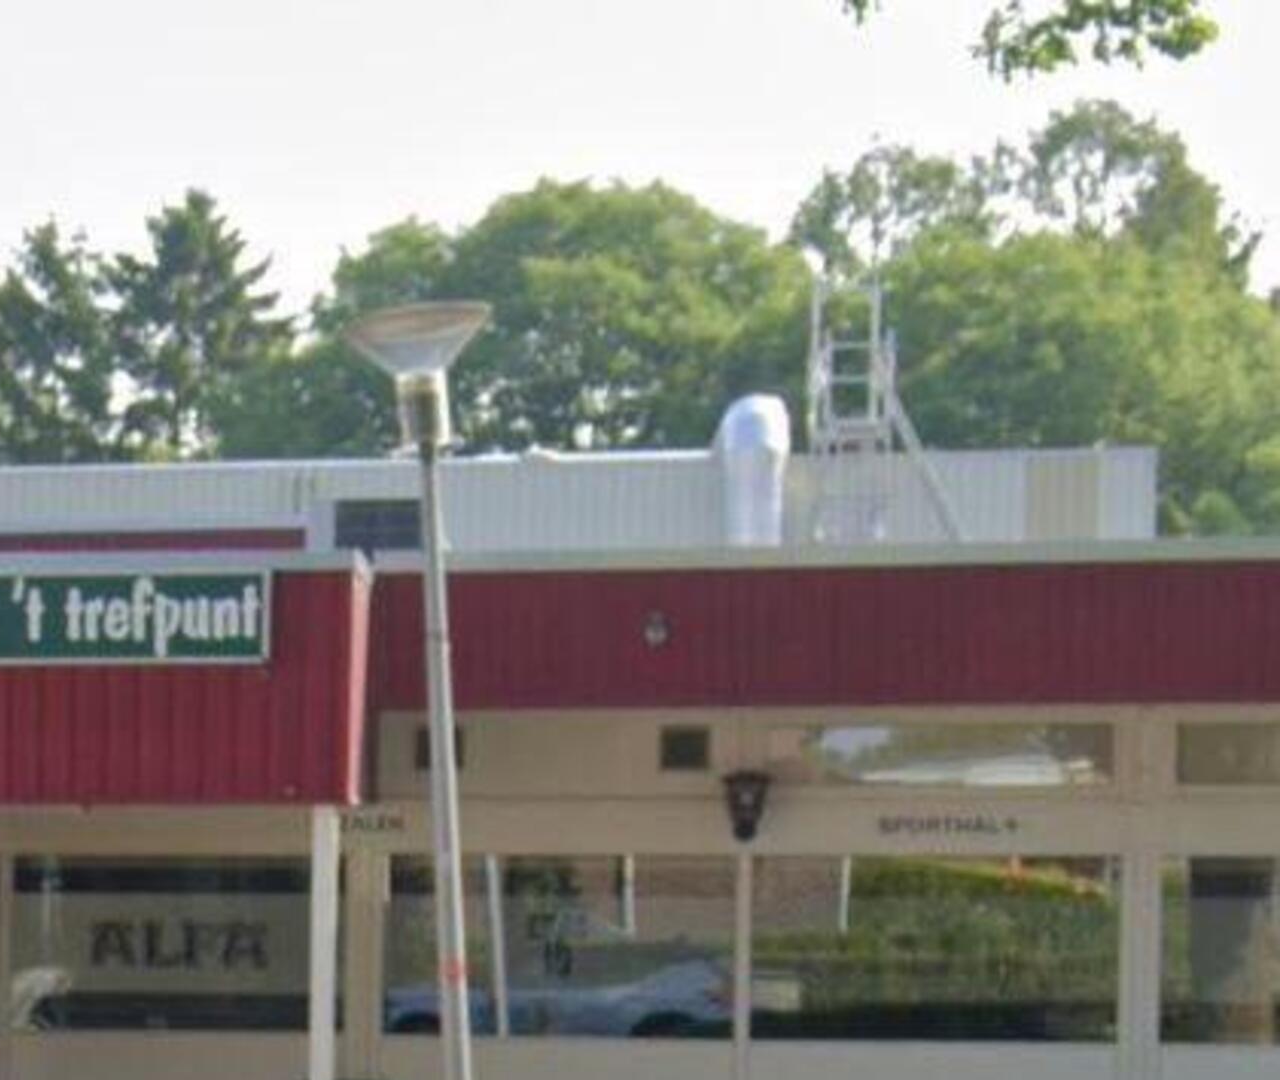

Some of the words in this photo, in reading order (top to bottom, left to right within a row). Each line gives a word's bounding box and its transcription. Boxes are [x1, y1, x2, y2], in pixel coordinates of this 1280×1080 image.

[12, 577, 45, 642] 't
[65, 577, 263, 658] trefpunt
[92, 918, 269, 970] ALFA
